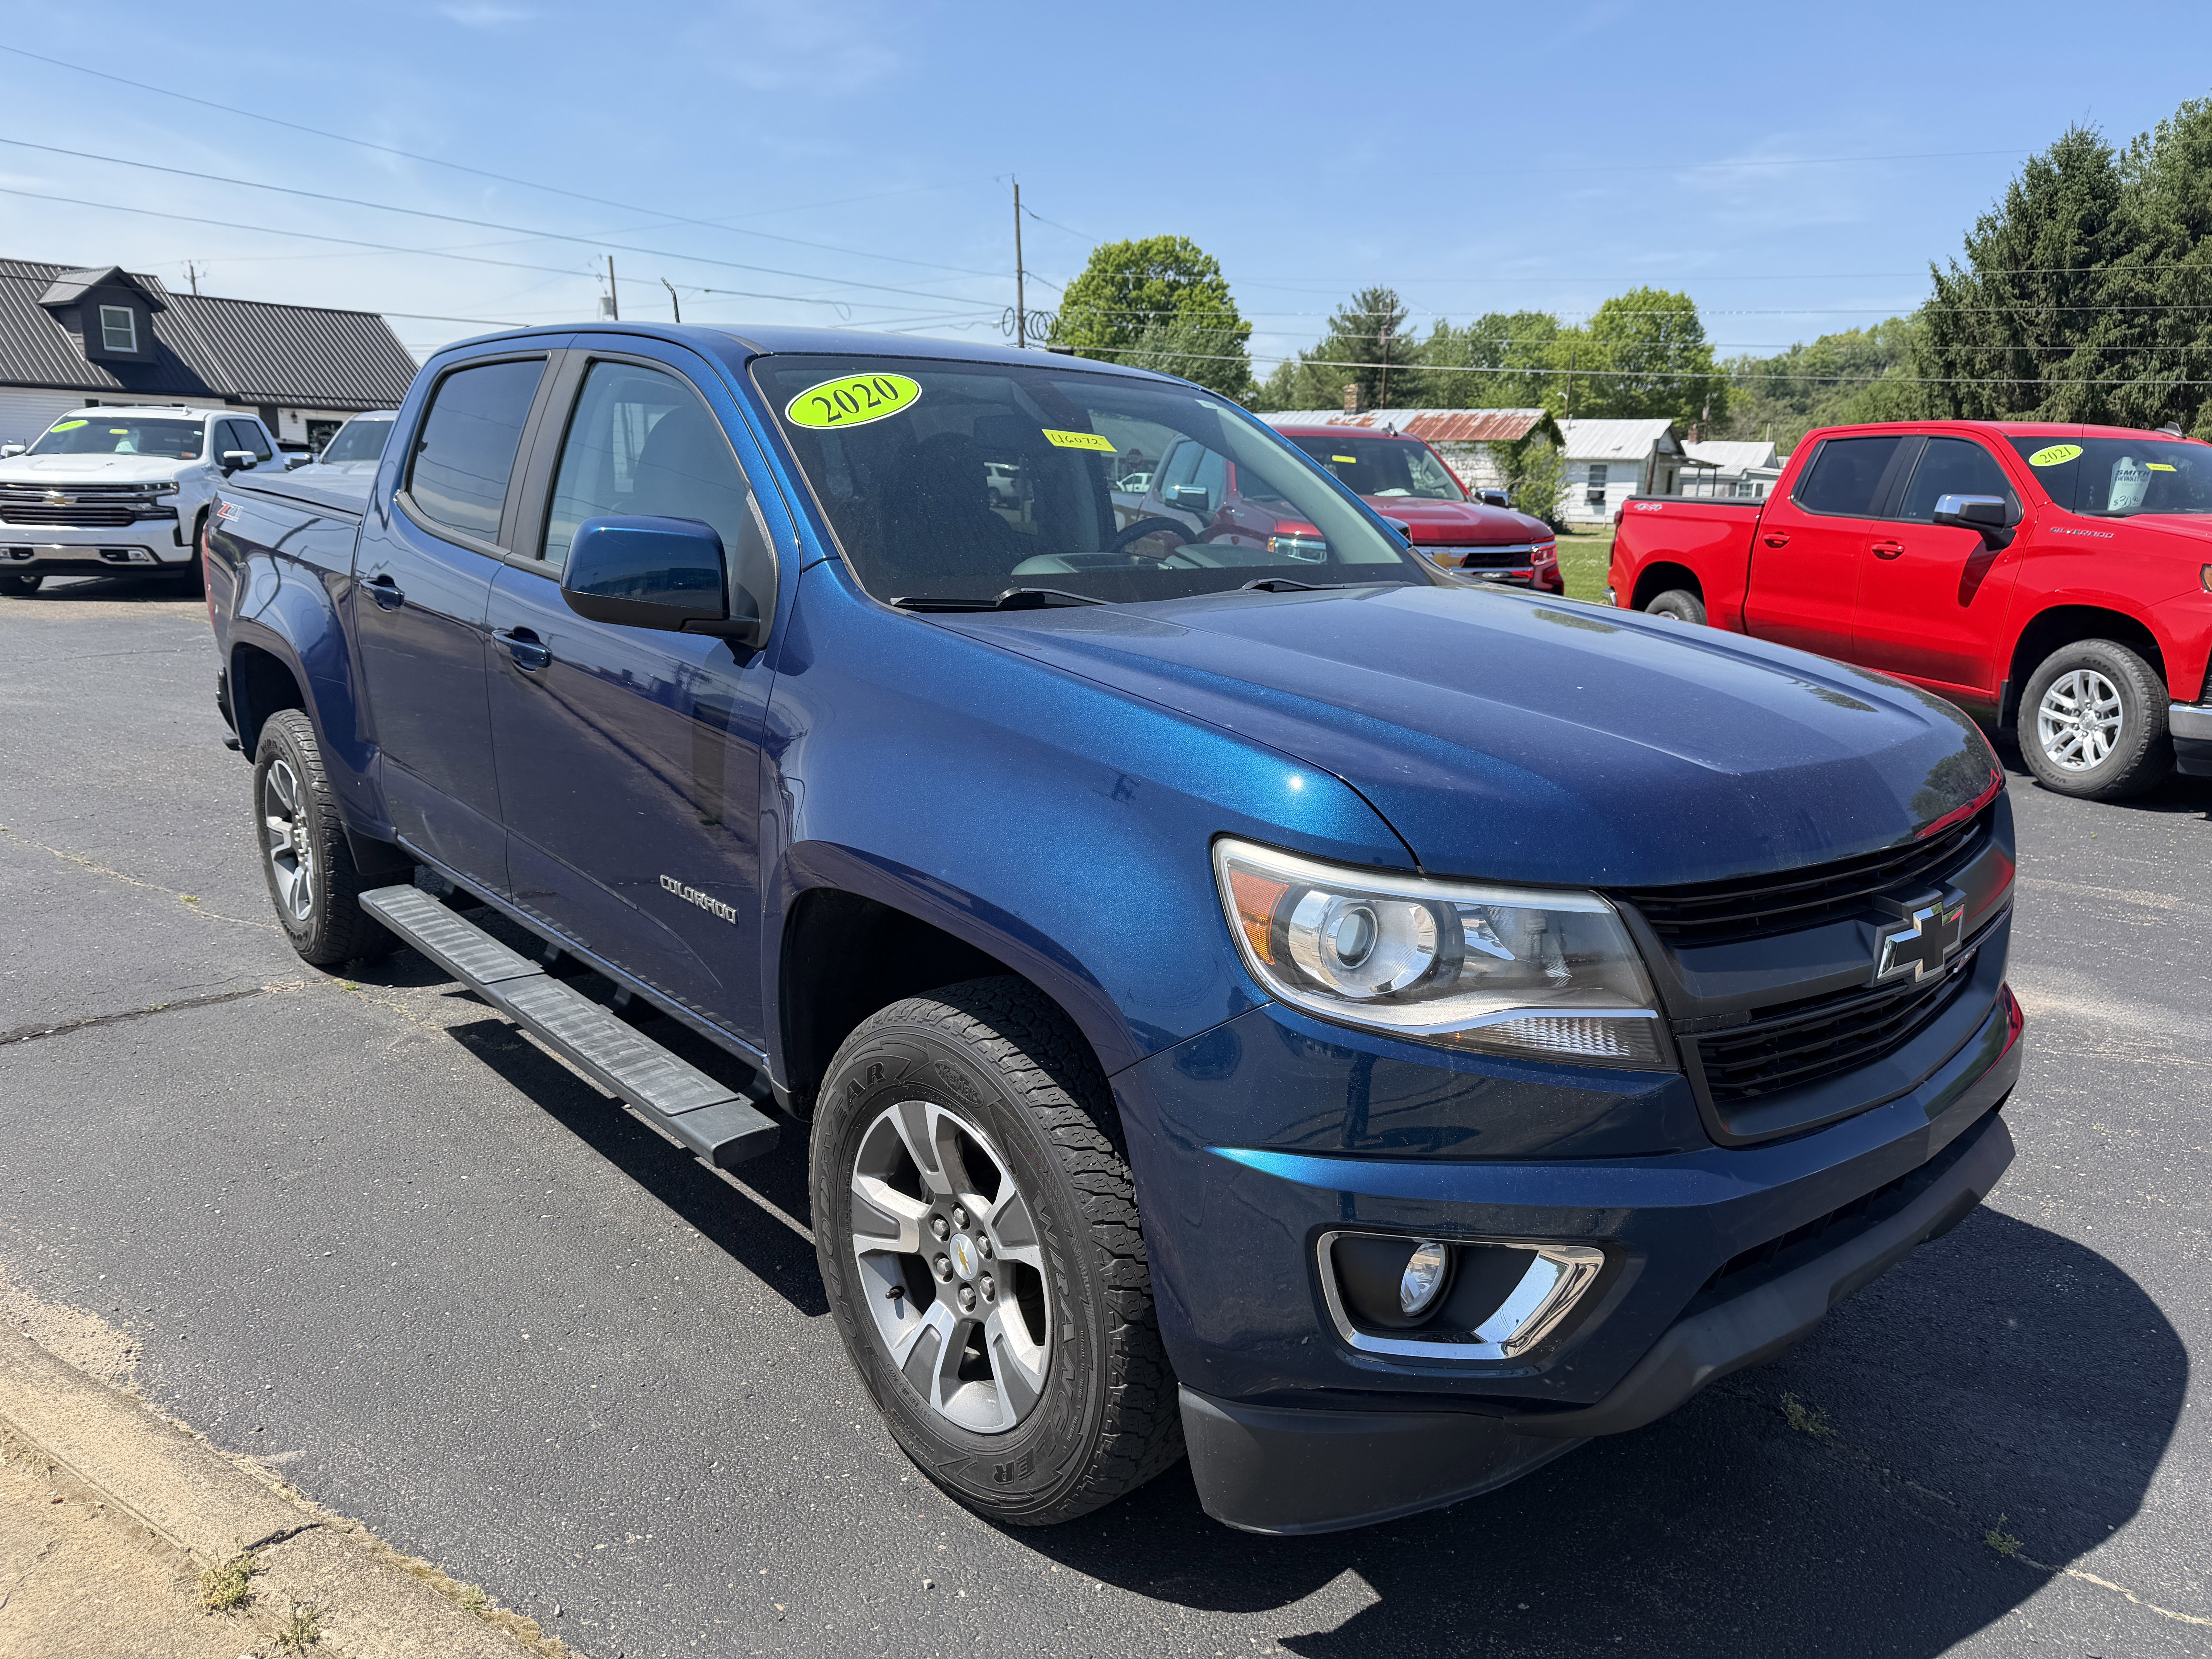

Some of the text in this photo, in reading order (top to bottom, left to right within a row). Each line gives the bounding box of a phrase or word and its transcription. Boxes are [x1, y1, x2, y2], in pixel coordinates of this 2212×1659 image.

[812, 377, 899, 423] 2020
[2039, 447, 2072, 464] 2021
[216, 500, 245, 523] Z71
[2050, 527, 2114, 539] SILVERADO
[659, 874, 739, 925] COLORADO
[820, 1061, 886, 1338] GOODYEAR
